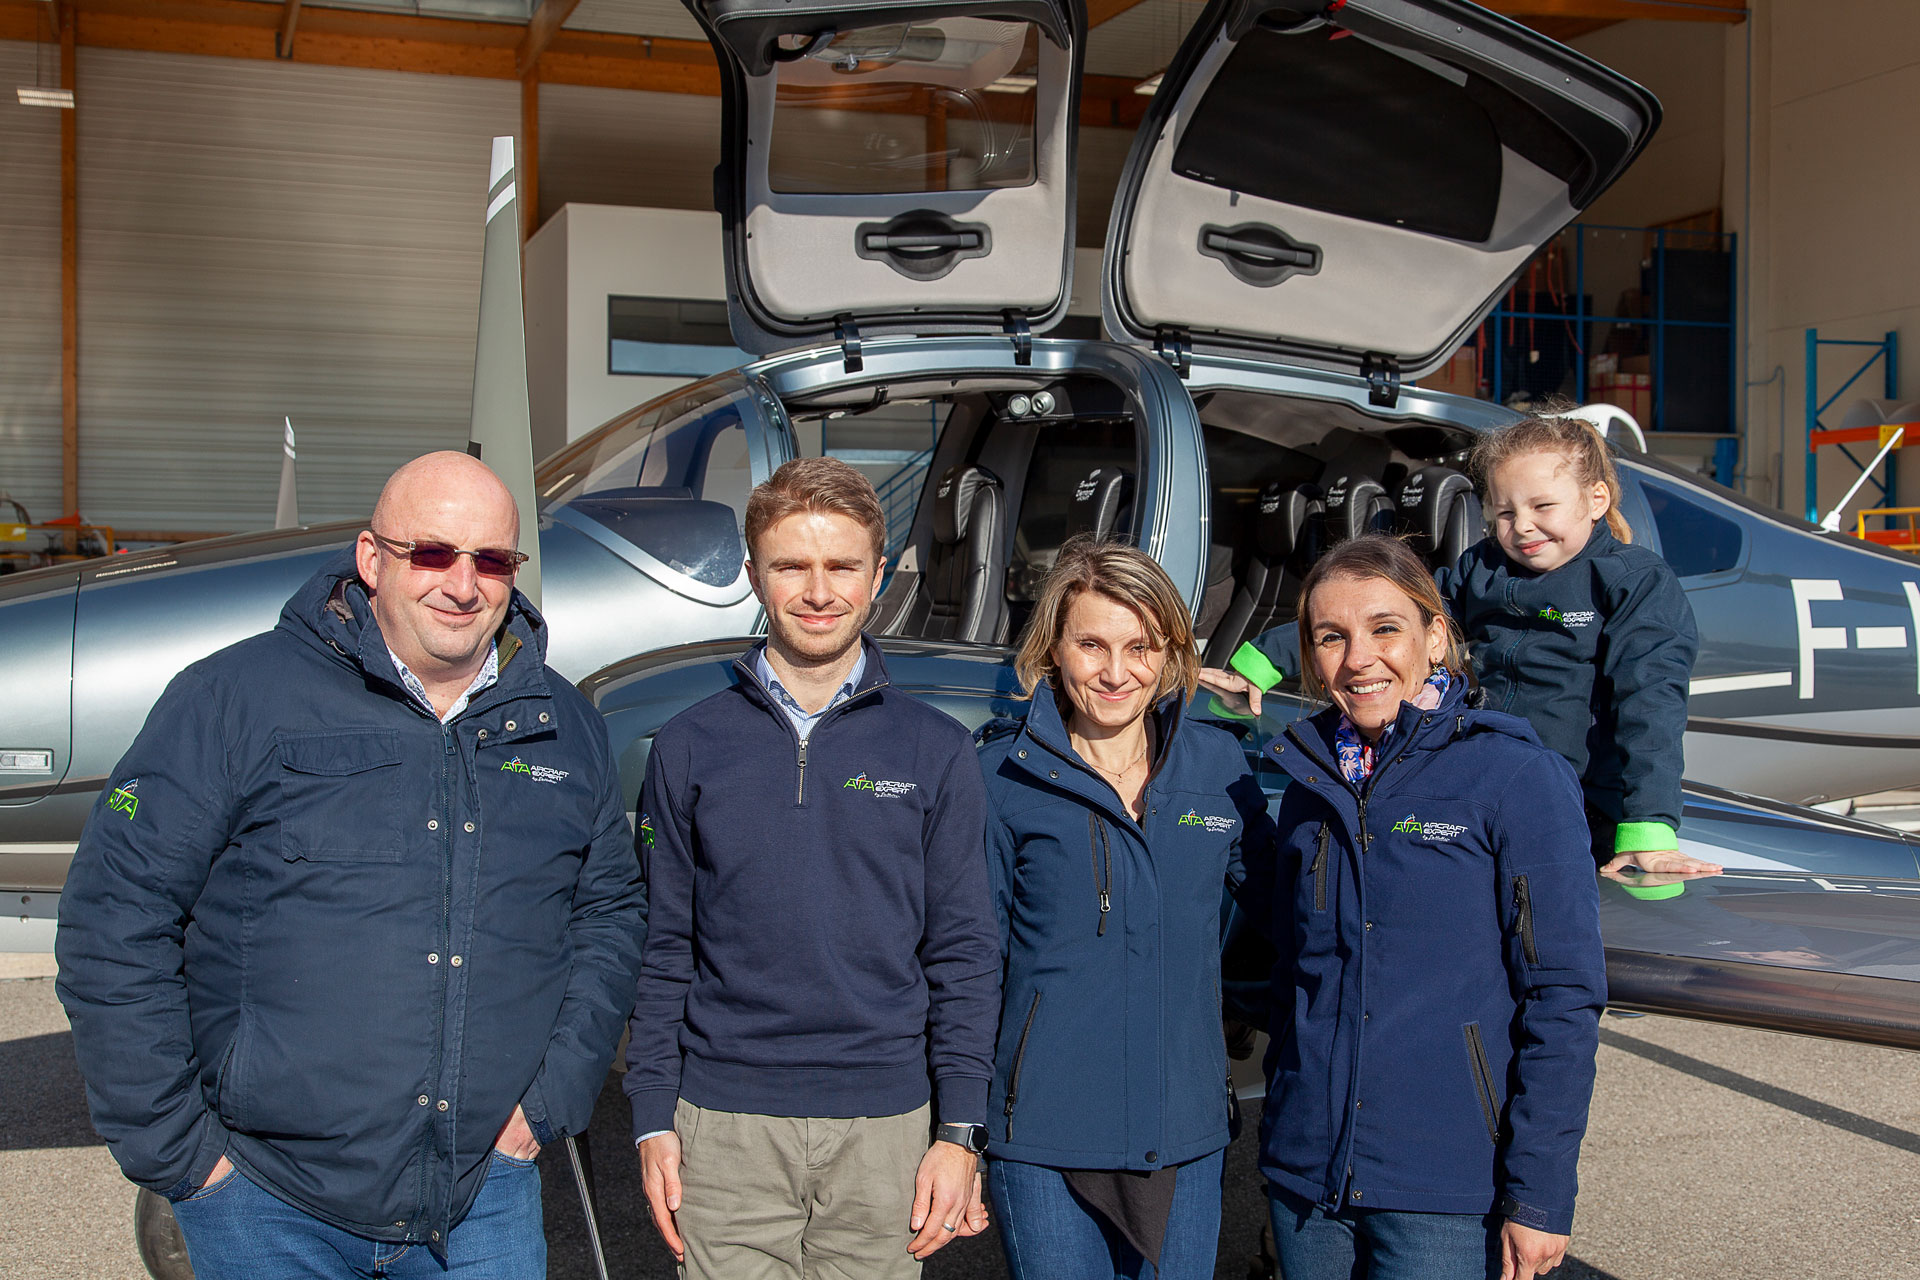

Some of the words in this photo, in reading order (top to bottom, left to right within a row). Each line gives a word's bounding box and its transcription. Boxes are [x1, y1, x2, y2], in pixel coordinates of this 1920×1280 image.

[1538, 609, 1563, 622] ATA
[501, 761, 531, 775] ATA
[531, 770, 564, 781] EXPERT
[843, 778, 875, 792] ATA
[875, 780, 917, 790] AIRCRAFT
[875, 786, 910, 794] EXPERT
[104, 787, 139, 820] ATA
[1178, 815, 1205, 826] ATA
[1391, 821, 1423, 834] ATA
[1423, 822, 1468, 833] AIRCRAFT
[1423, 827, 1460, 838] EXPERT
